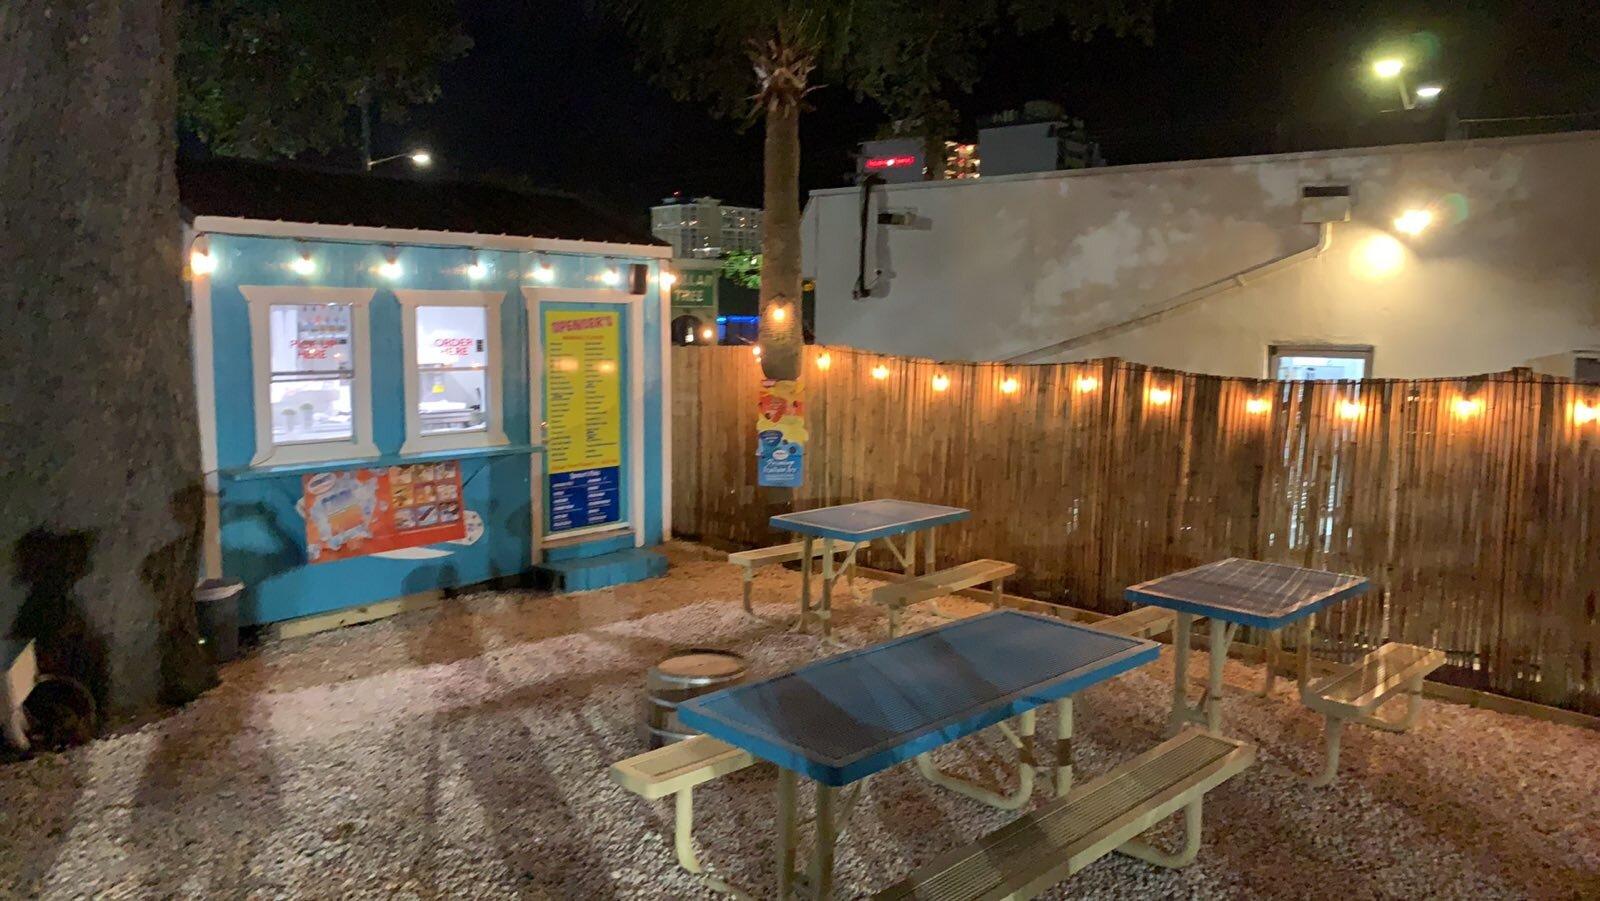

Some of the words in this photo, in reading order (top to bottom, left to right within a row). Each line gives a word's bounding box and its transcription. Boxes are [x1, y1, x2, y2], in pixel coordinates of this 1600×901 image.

[434, 338, 472, 347] ORDER
[298, 349, 326, 359] HERE
[440, 347, 469, 356] HERE
